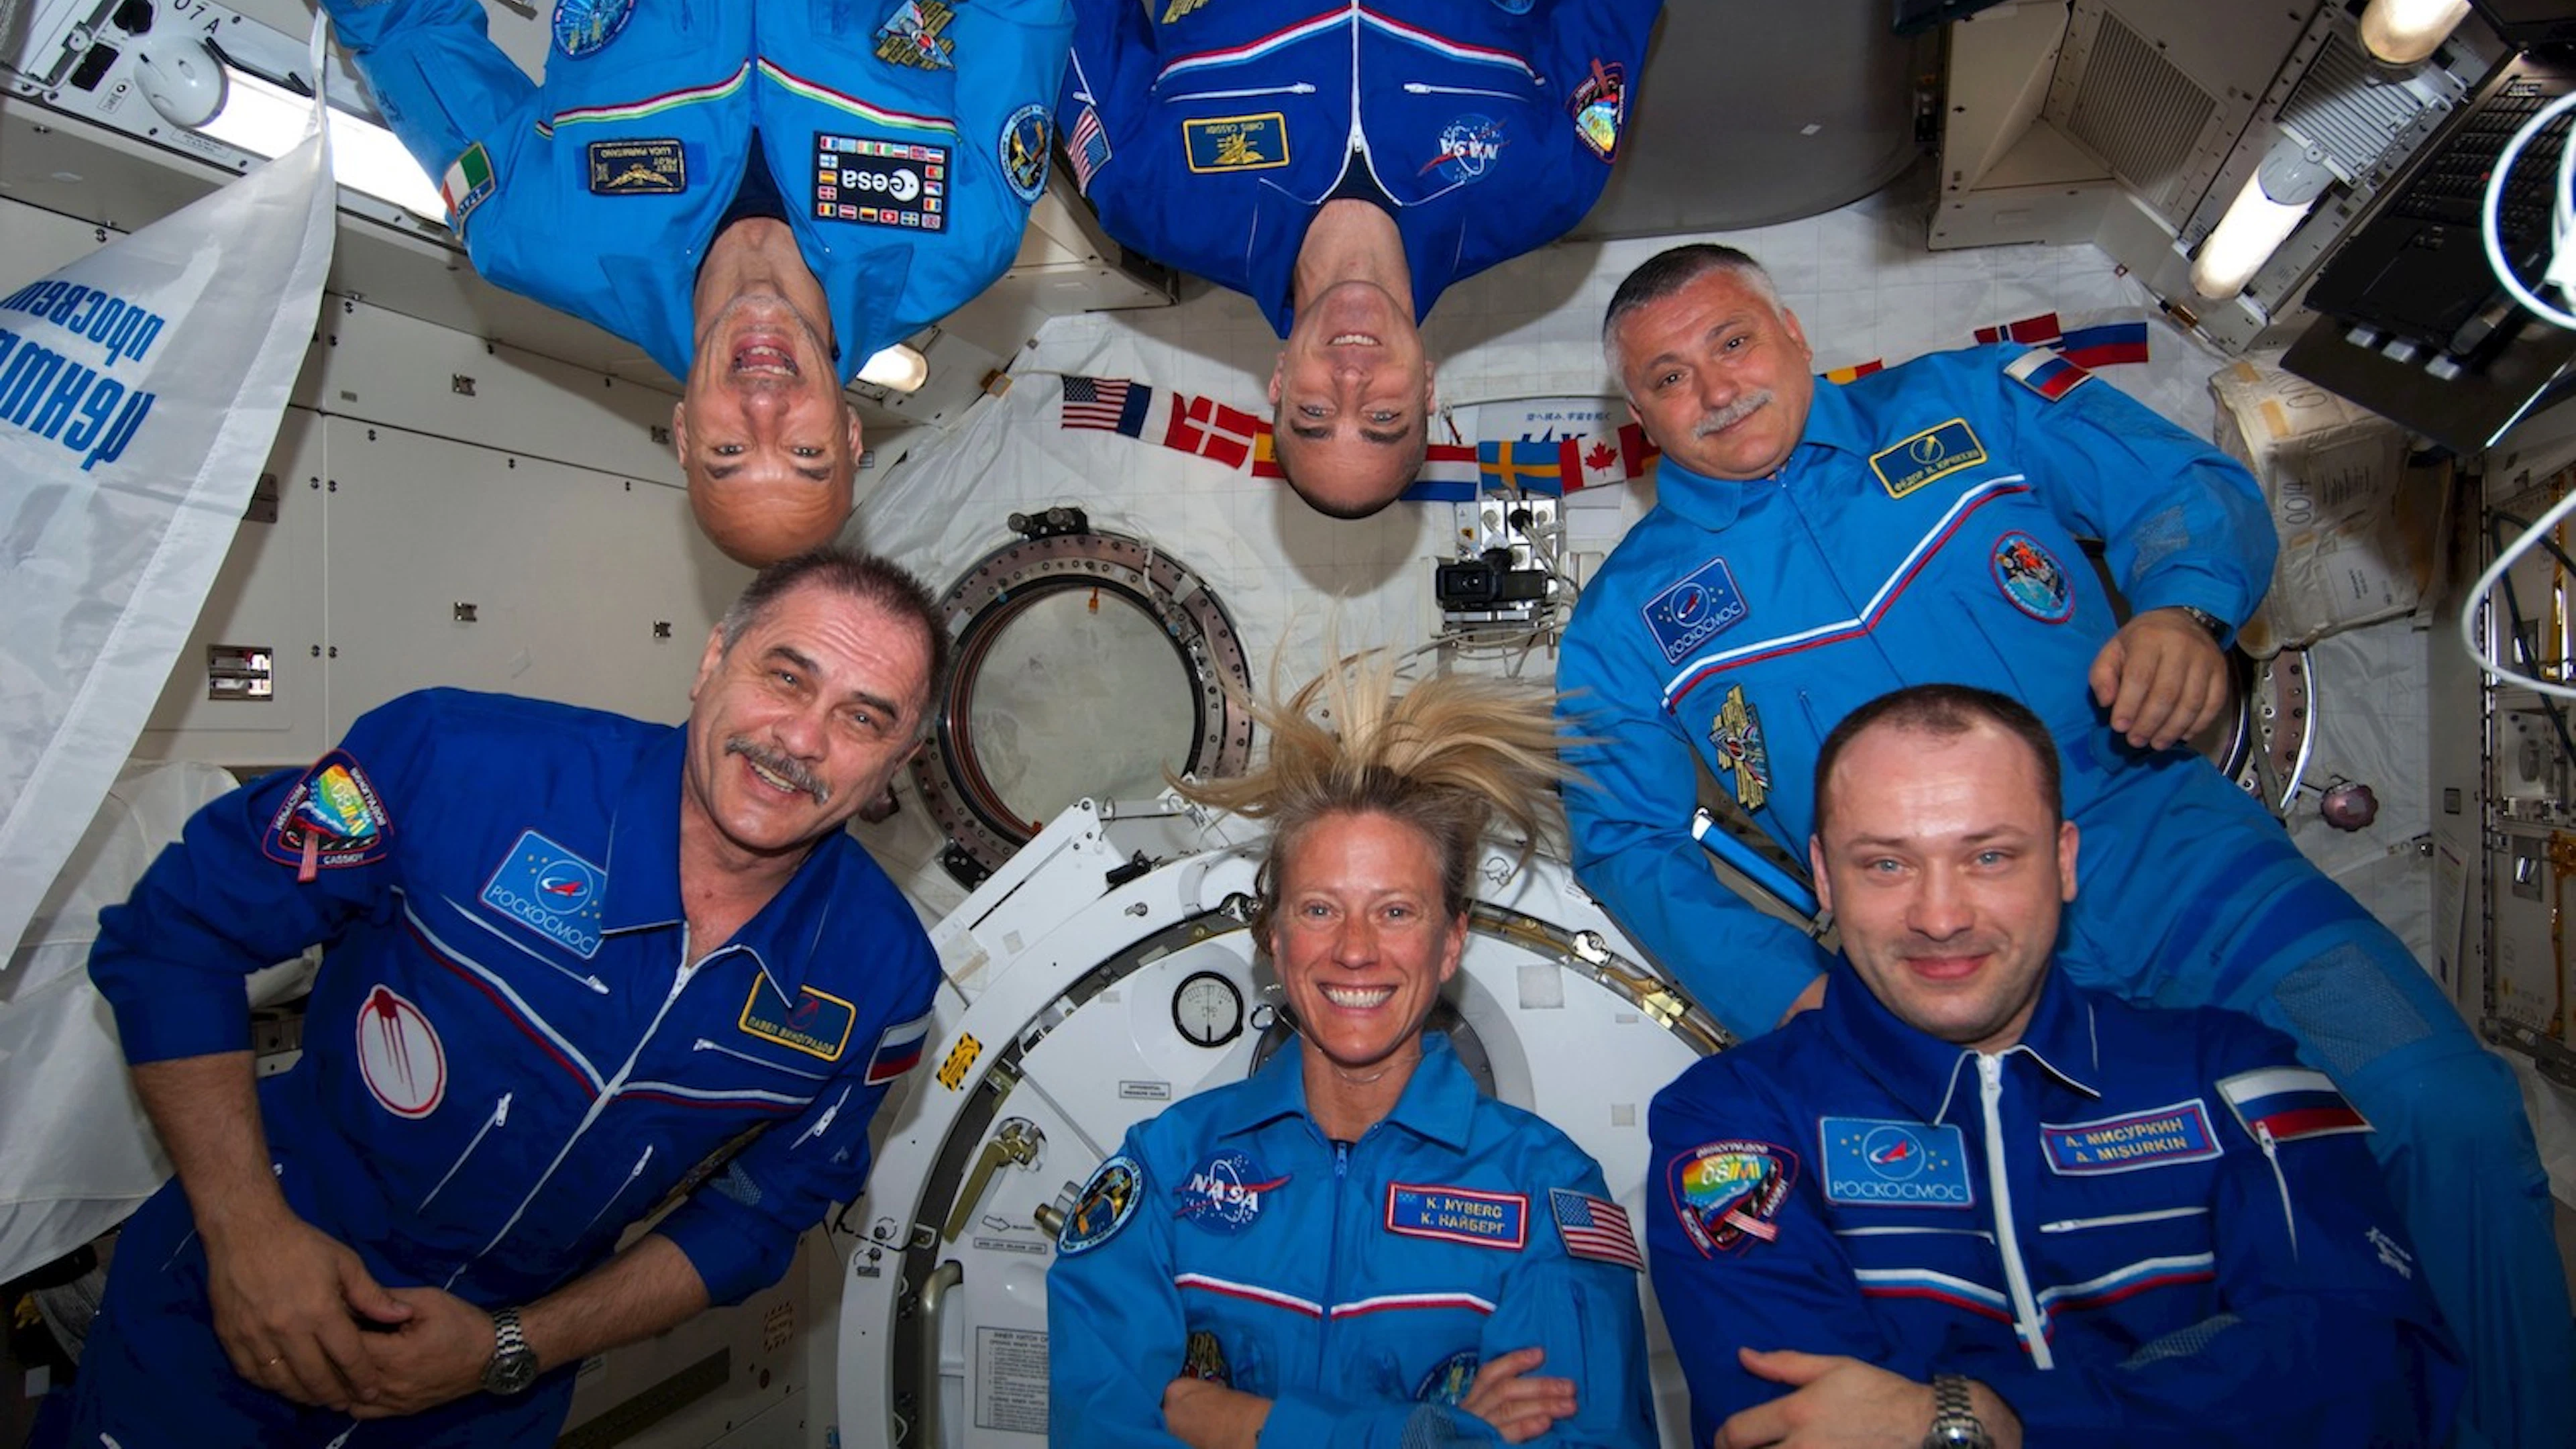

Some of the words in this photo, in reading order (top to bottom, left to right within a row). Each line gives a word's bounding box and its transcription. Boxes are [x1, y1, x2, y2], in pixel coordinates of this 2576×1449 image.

[649, 146, 672, 156] LUCA
[1440, 138, 1498, 160] NASA
[1670, 602, 1741, 658] РОСКОСМОС
[488, 884, 596, 954] РОСКОСМОС
[2088, 1117, 2184, 1146] МИСУРКИН
[2098, 1136, 2188, 1162] MISURKIN
[1189, 1173, 1259, 1212] NASA
[1833, 1181, 1964, 1201] РОСКОСМОС
[1445, 1198, 1503, 1219] NYBERG
[1438, 1214, 1505, 1234] НАЙБЕРГ
